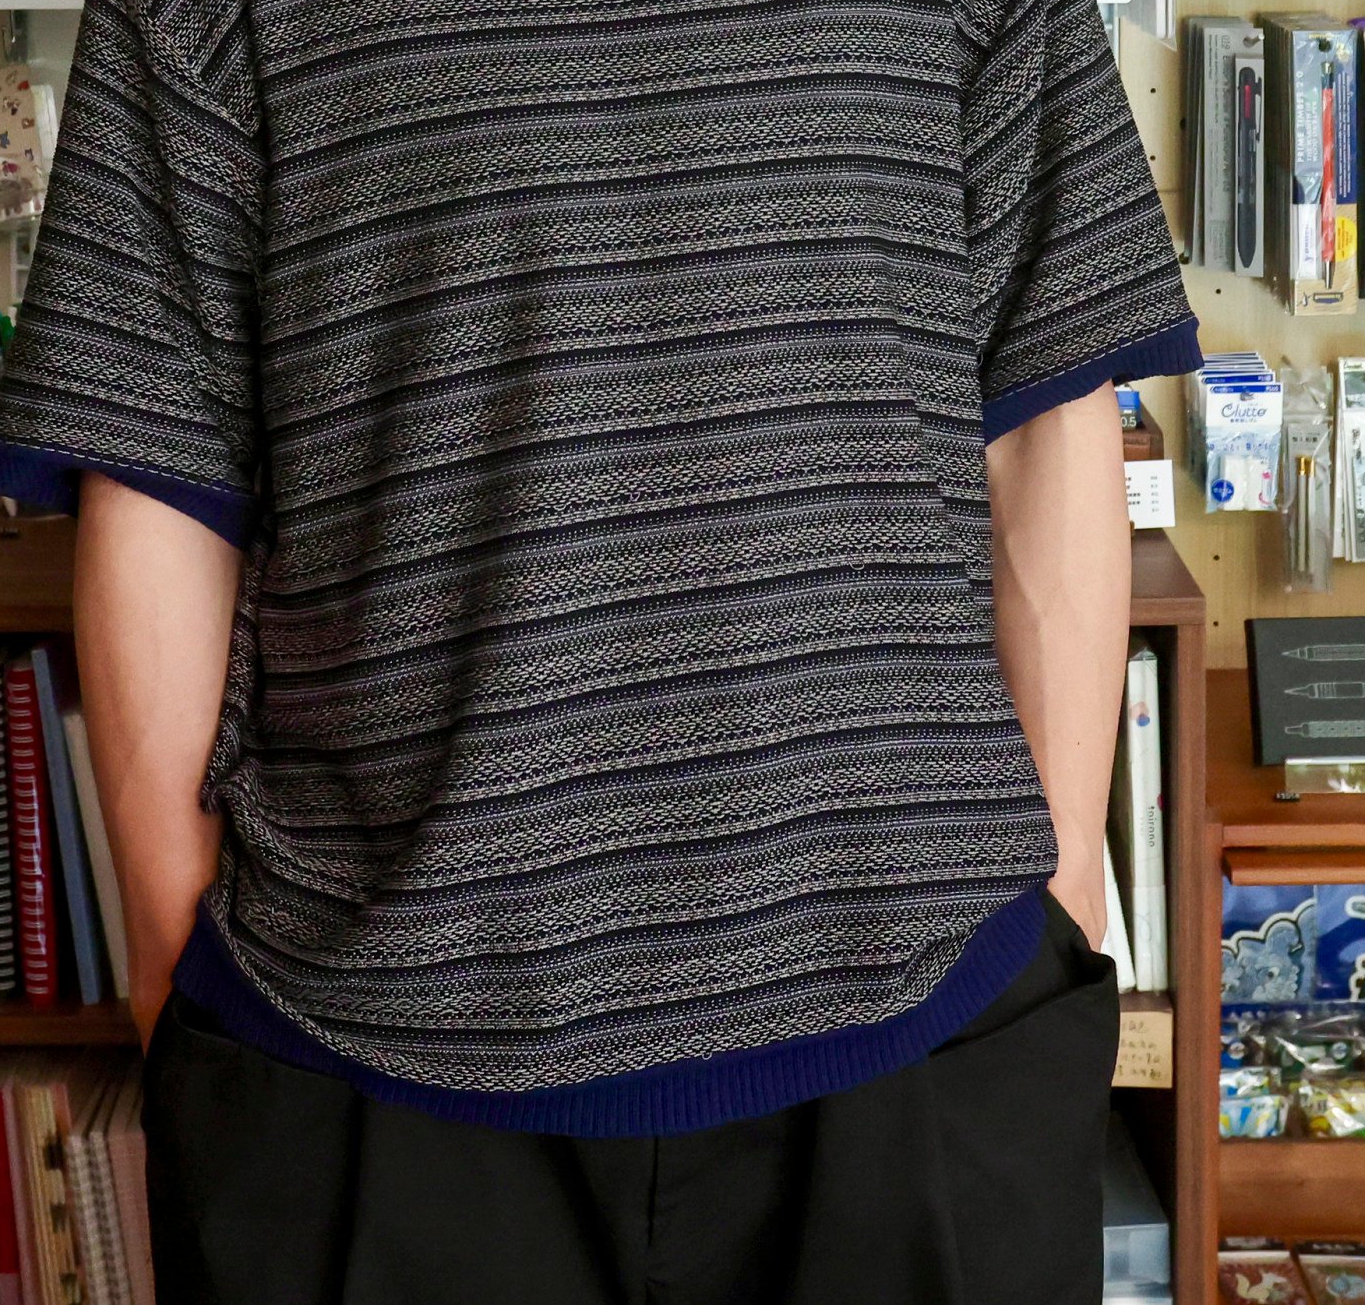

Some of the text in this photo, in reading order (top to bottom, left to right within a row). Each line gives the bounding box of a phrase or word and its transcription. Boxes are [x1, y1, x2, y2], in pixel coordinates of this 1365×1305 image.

[1296, 92, 1304, 163] PRIME TIMBER
[1120, 416, 1137, 429] 0.5
